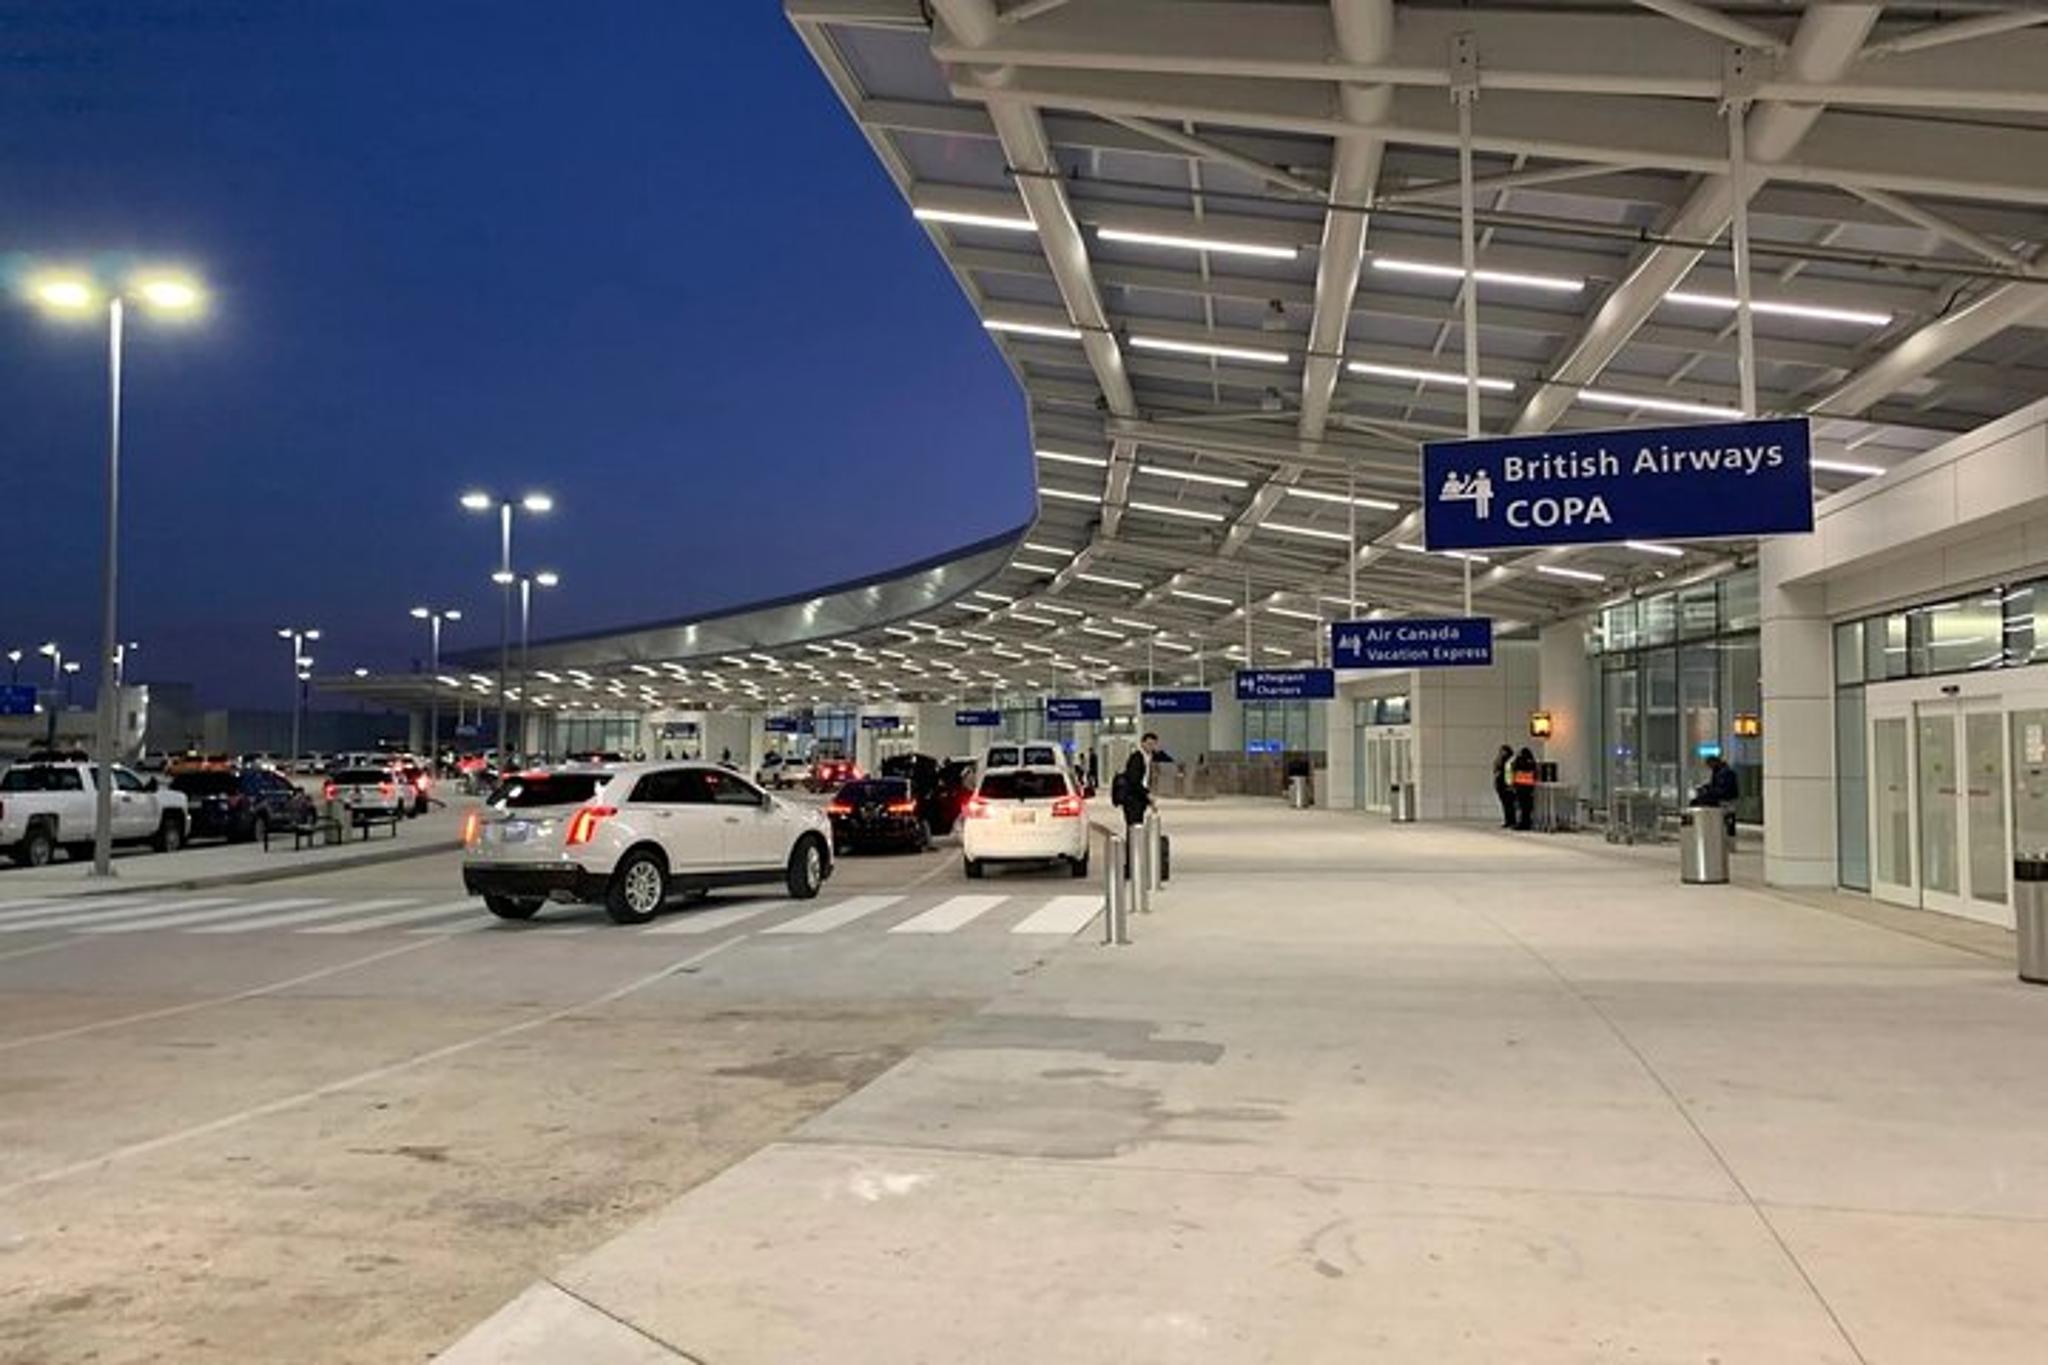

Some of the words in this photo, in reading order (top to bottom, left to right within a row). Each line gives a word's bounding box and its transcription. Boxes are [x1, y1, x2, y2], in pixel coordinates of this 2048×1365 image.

[1504, 449, 1619, 482] British
[1633, 444, 1783, 475] Airways
[1506, 496, 1612, 527] COPA
[1366, 627, 1391, 642] Air
[1396, 625, 1460, 641] Canada
[1367, 648, 1429, 661] Vacation
[1433, 646, 1488, 662] Express
